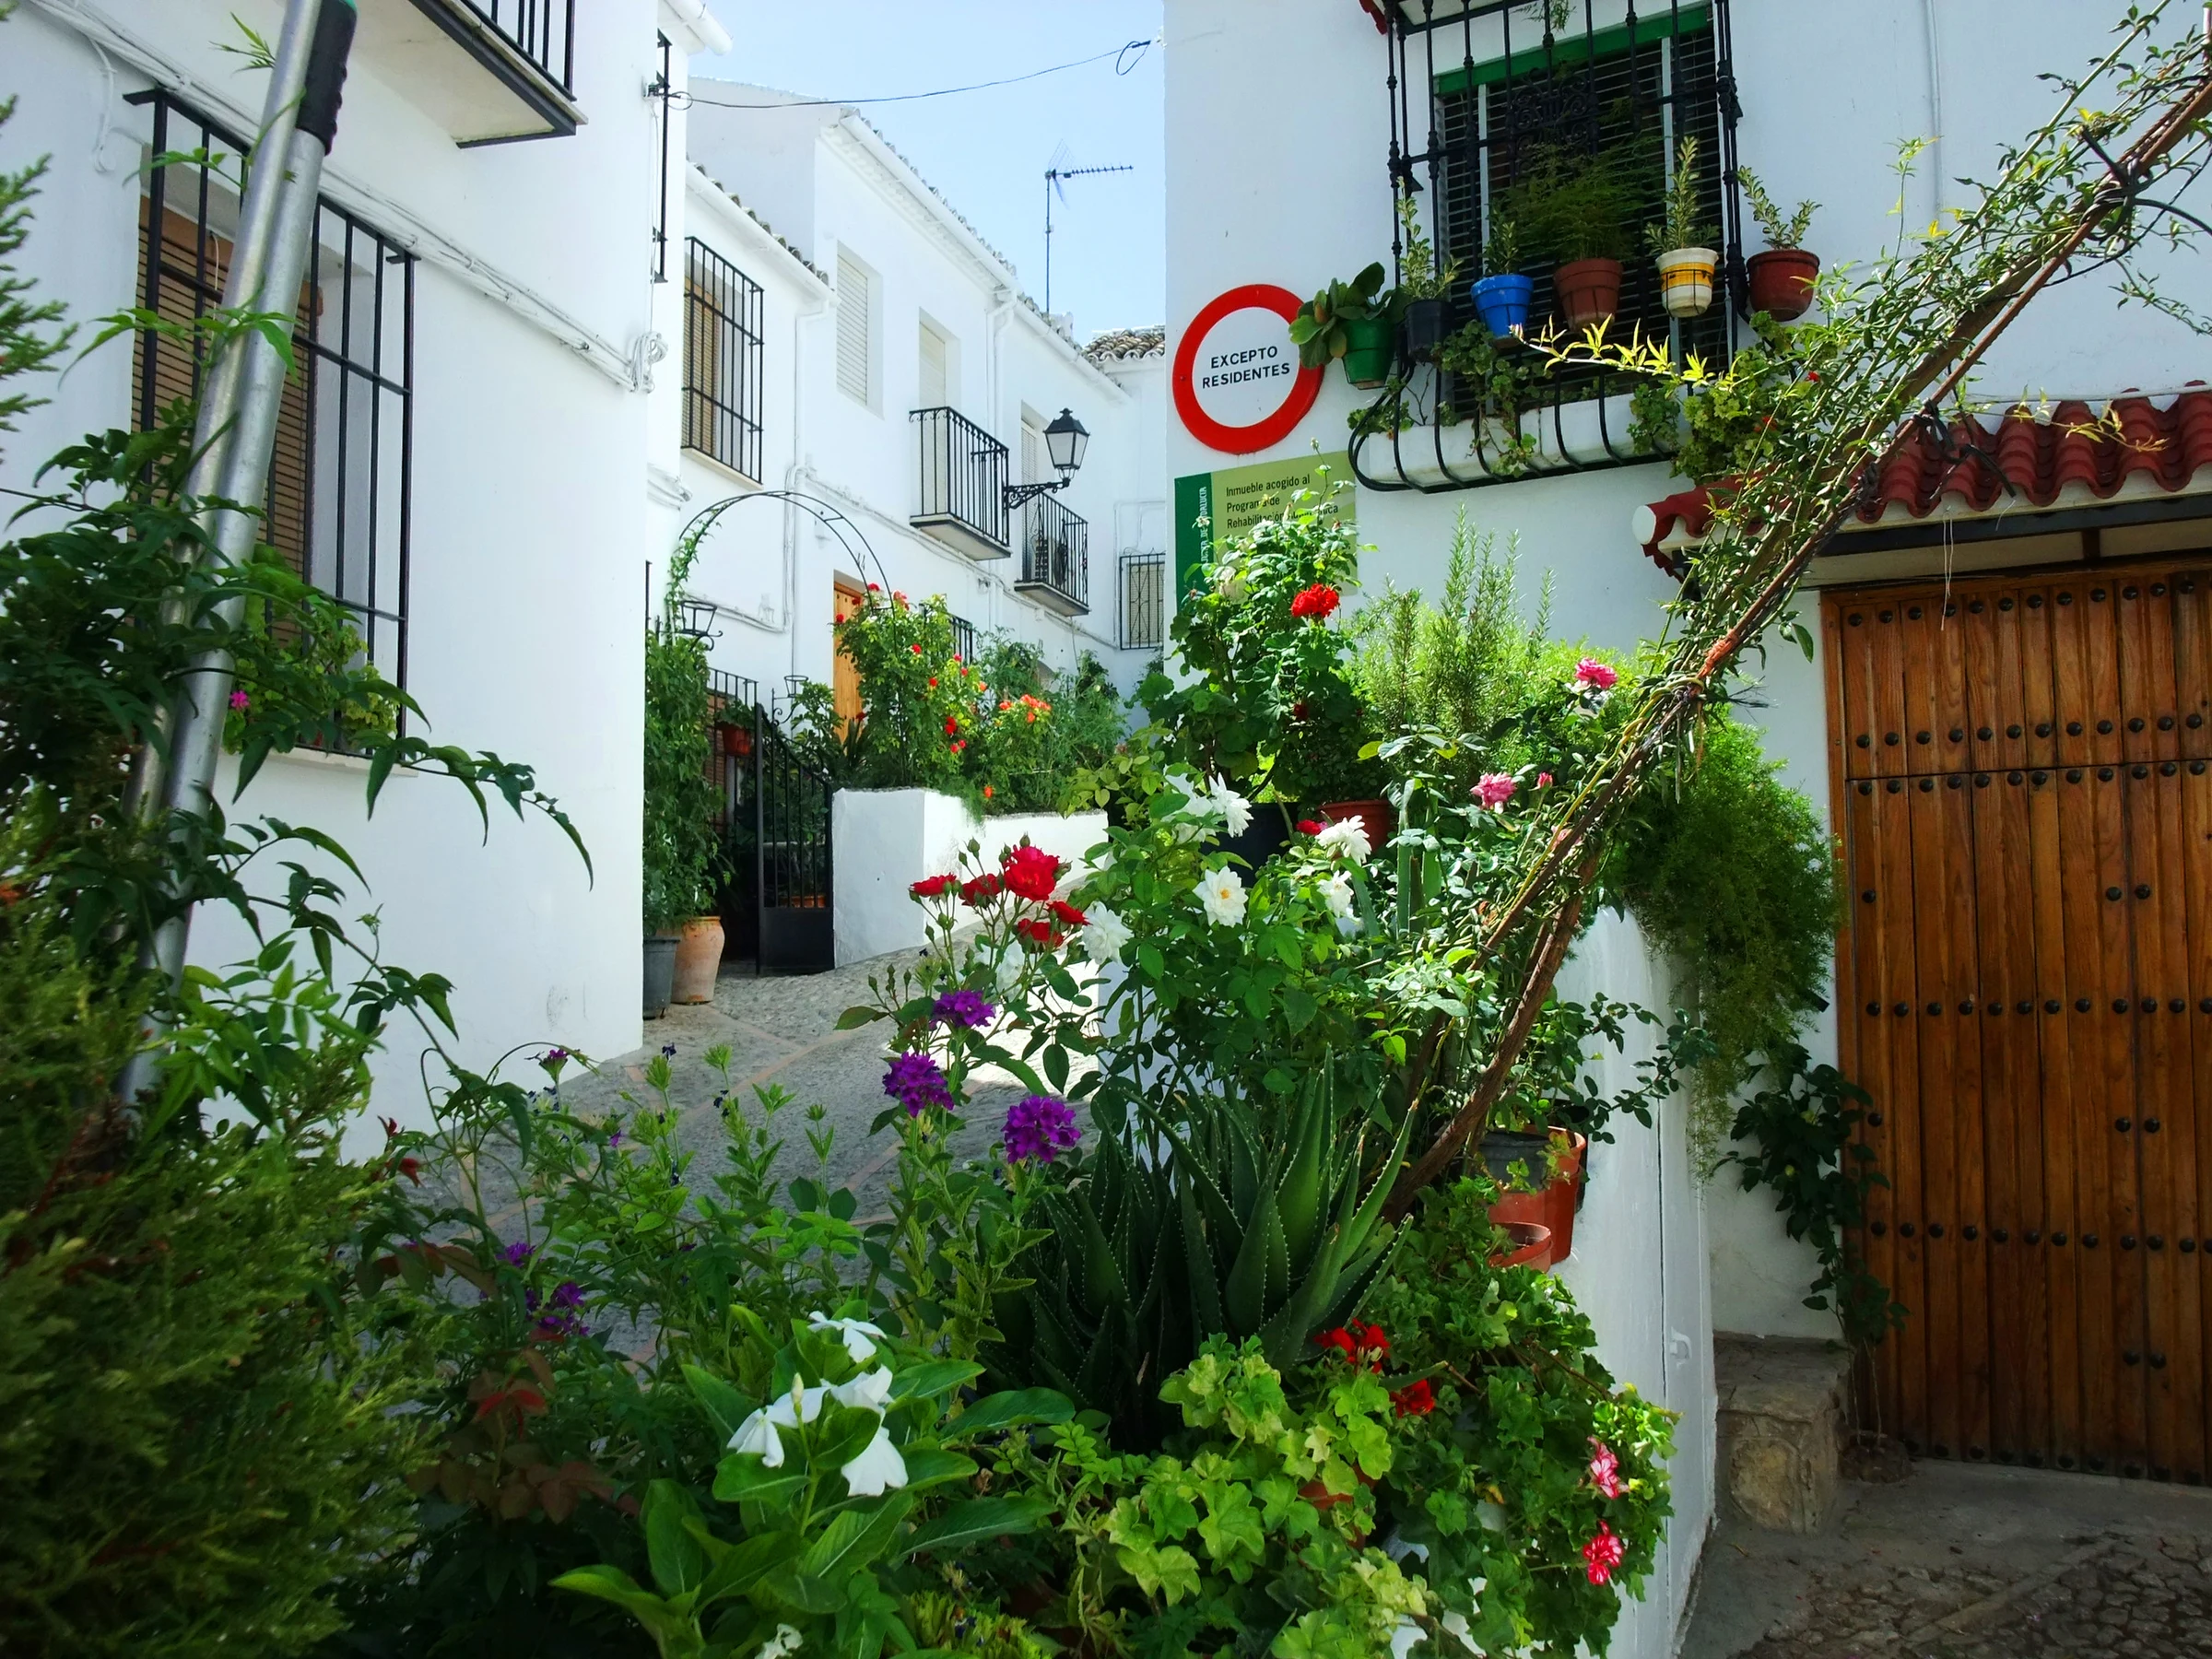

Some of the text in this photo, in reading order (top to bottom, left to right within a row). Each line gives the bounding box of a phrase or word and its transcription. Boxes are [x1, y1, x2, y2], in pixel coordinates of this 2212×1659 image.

[1211, 346, 1277, 369] EXCEPTO
[1202, 362, 1290, 389] RESIDENTES
[1226, 474, 1311, 497] Inmueble acogido al
[1199, 487, 1207, 526] DALUCIA
[1269, 496, 1280, 506] de
